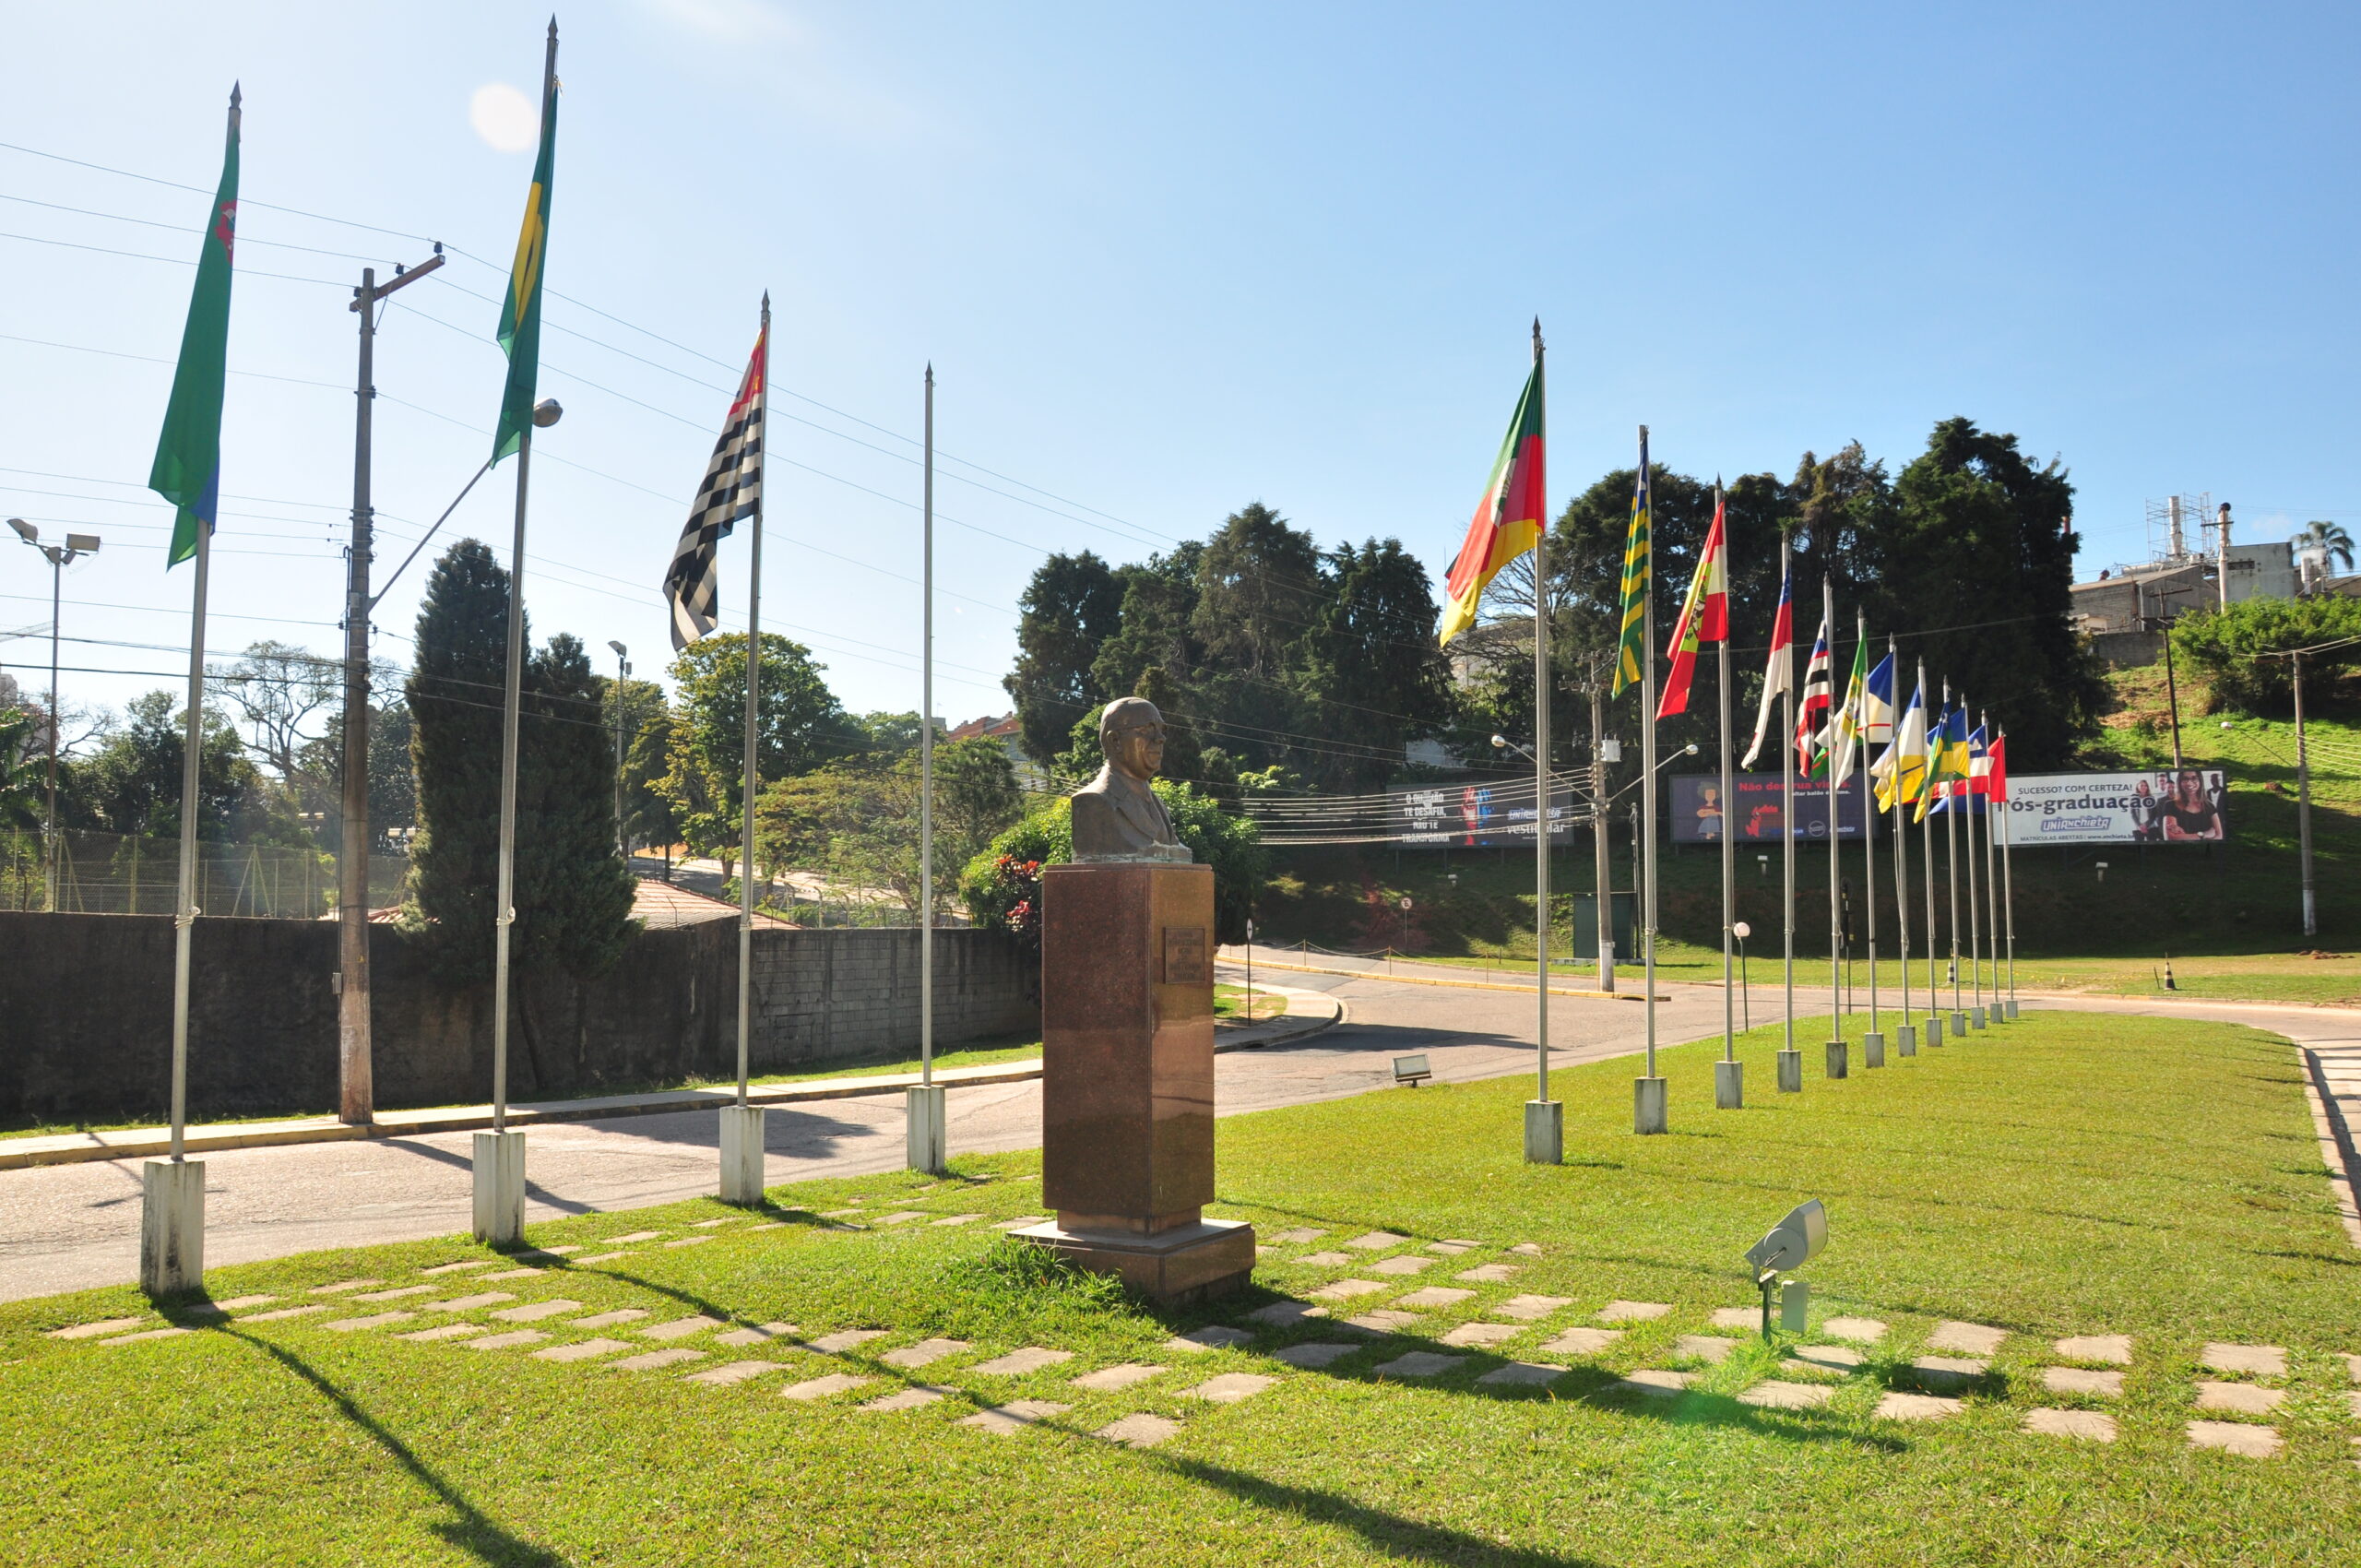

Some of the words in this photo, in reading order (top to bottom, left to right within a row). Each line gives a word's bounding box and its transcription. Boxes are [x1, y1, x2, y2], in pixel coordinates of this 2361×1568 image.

[1738, 781, 1762, 791] Não
[1766, 781, 1812, 790] desrua
[2018, 786, 2063, 794] SUCESSO?
[2088, 784, 2133, 792] CERTEZA!
[1404, 808, 1414, 816] TE
